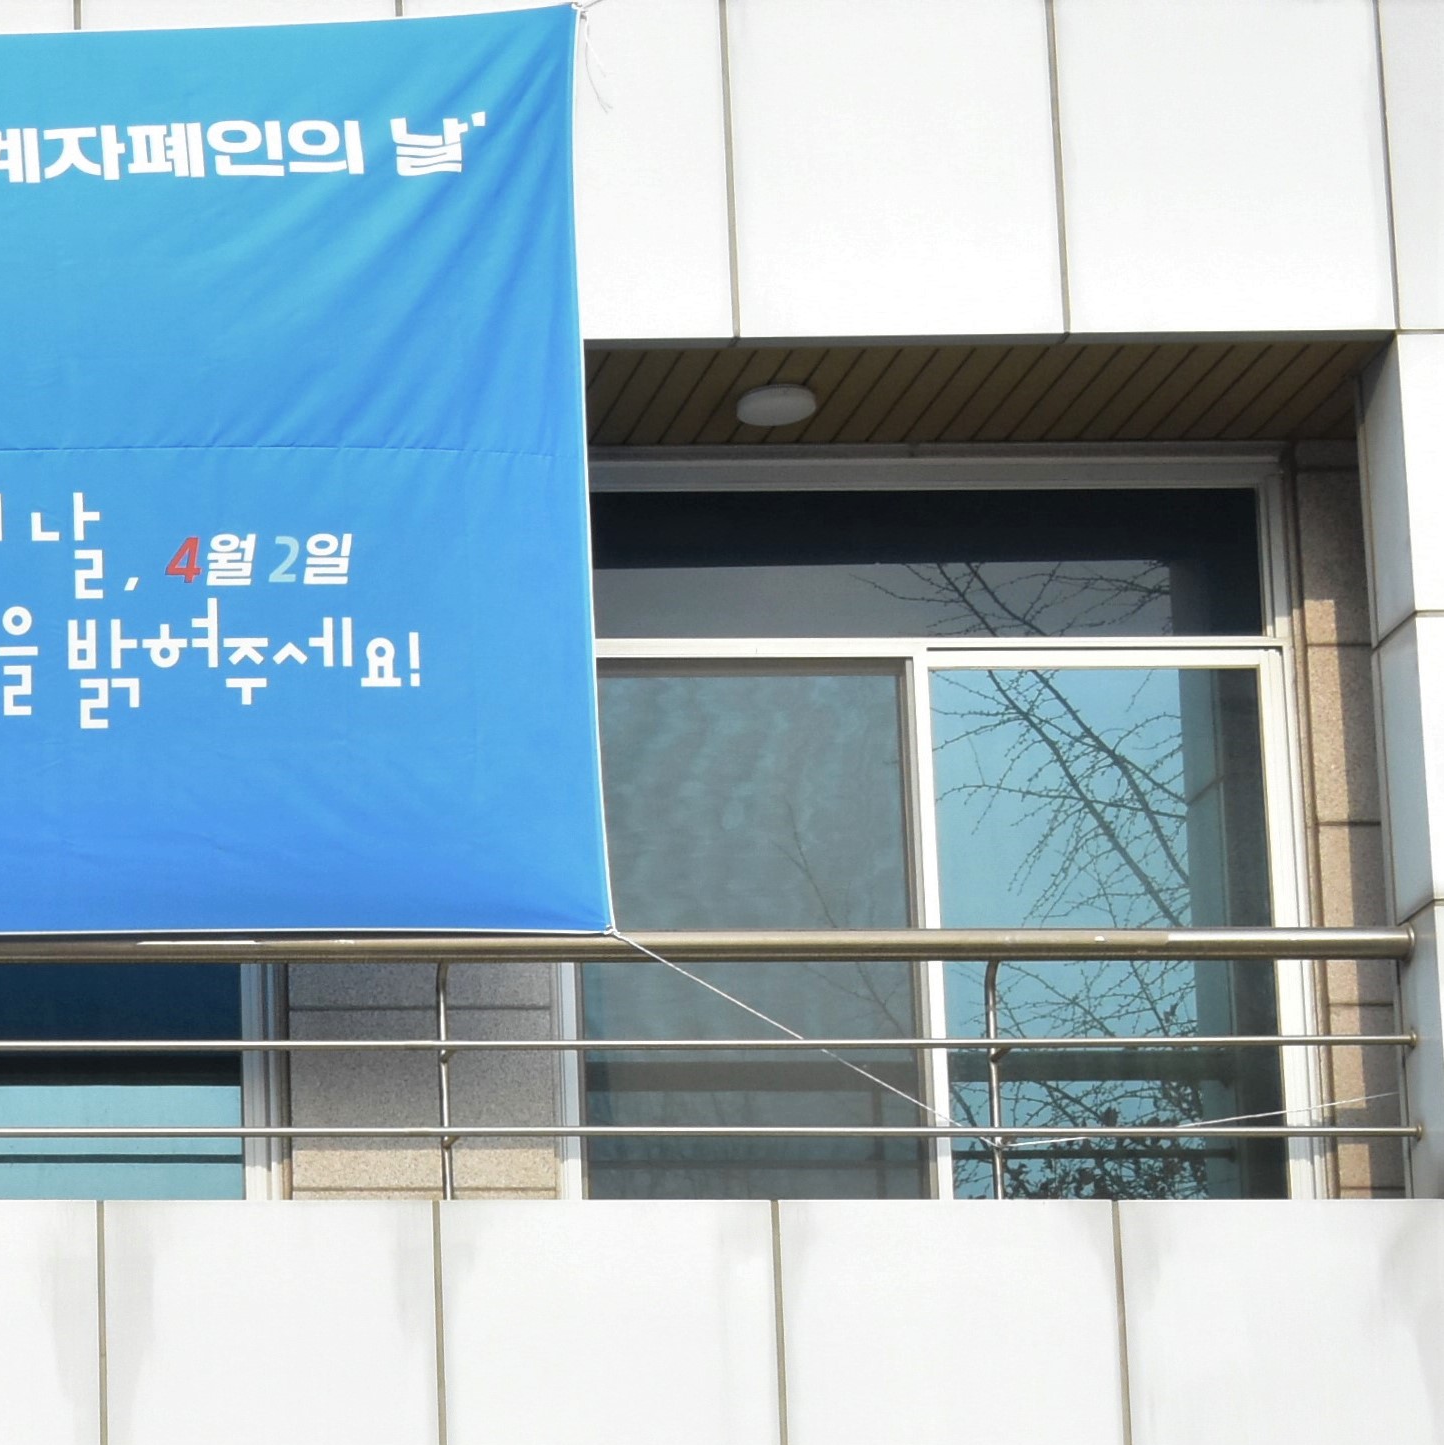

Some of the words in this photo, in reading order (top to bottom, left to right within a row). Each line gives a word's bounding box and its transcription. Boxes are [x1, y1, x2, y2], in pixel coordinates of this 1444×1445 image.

[30, 492, 139, 599] 날,
[164, 533, 257, 586] 4월
[268, 533, 353, 586] 2일
[67, 597, 421, 730] 밝혀주세요!
